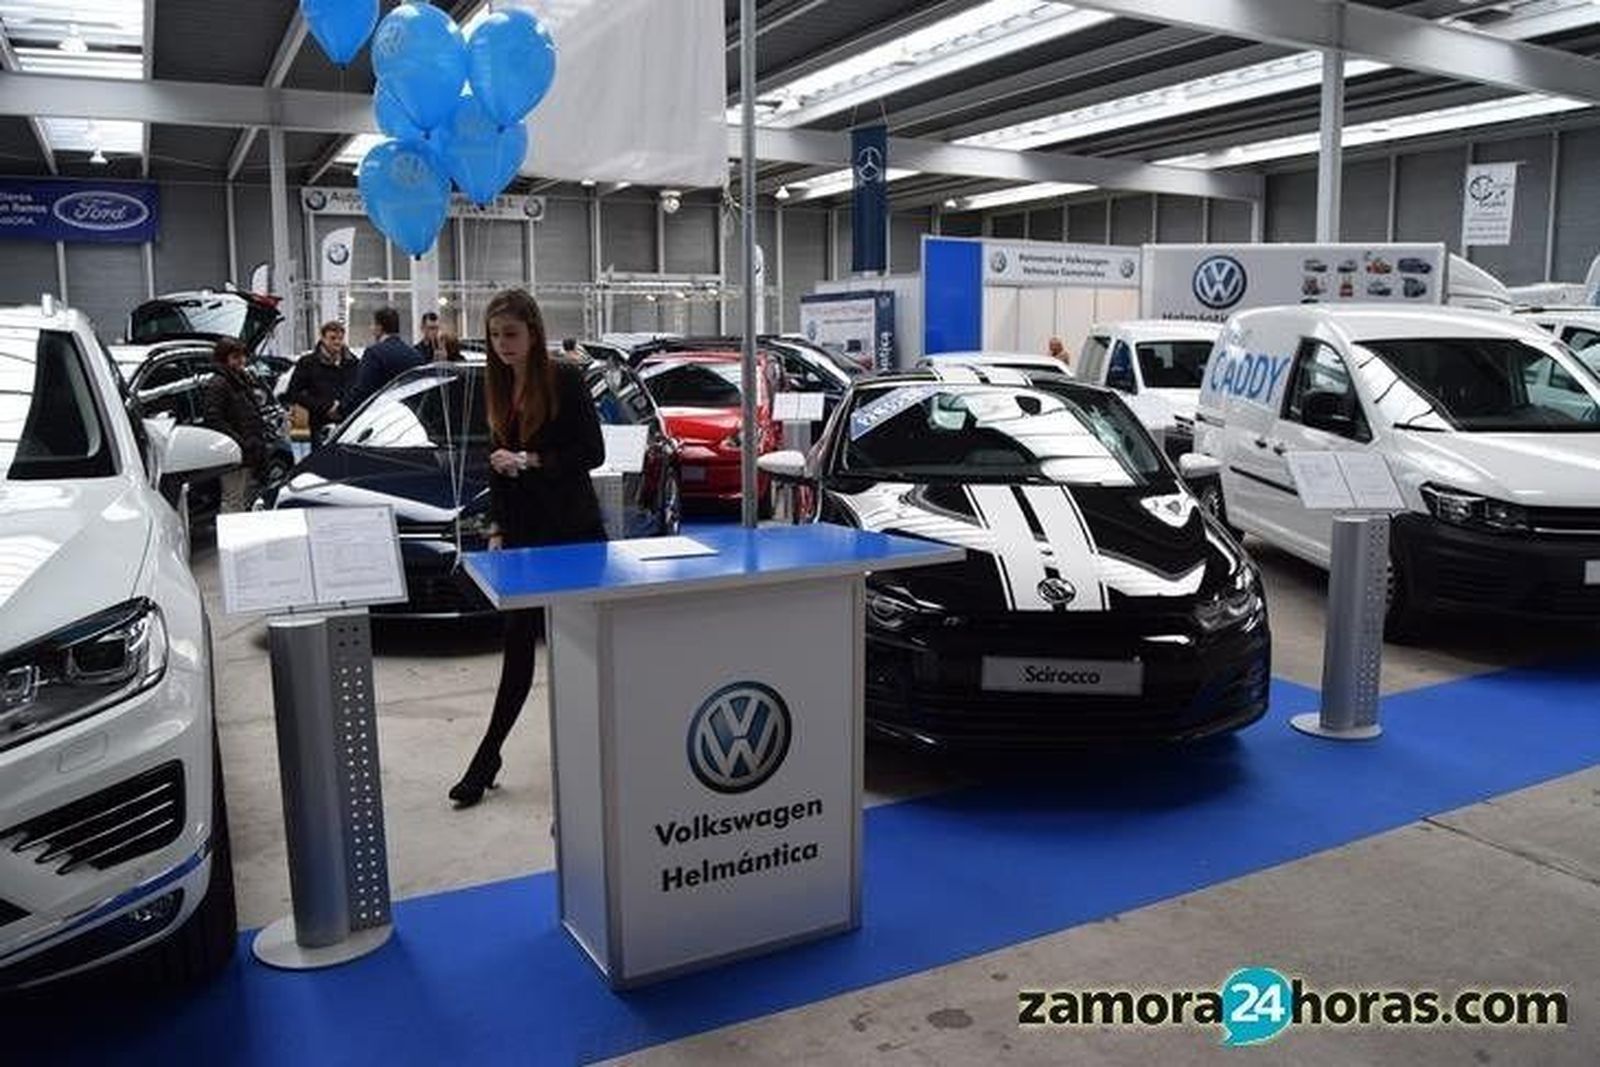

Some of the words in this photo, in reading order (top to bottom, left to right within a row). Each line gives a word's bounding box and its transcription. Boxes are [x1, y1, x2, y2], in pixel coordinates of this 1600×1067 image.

[73, 198, 127, 221] Ford
[1211, 351, 1290, 402] CADDY
[1024, 665, 1101, 684] Scirocco
[655, 799, 823, 847] Volkswagen
[661, 842, 819, 892] Helmántica
